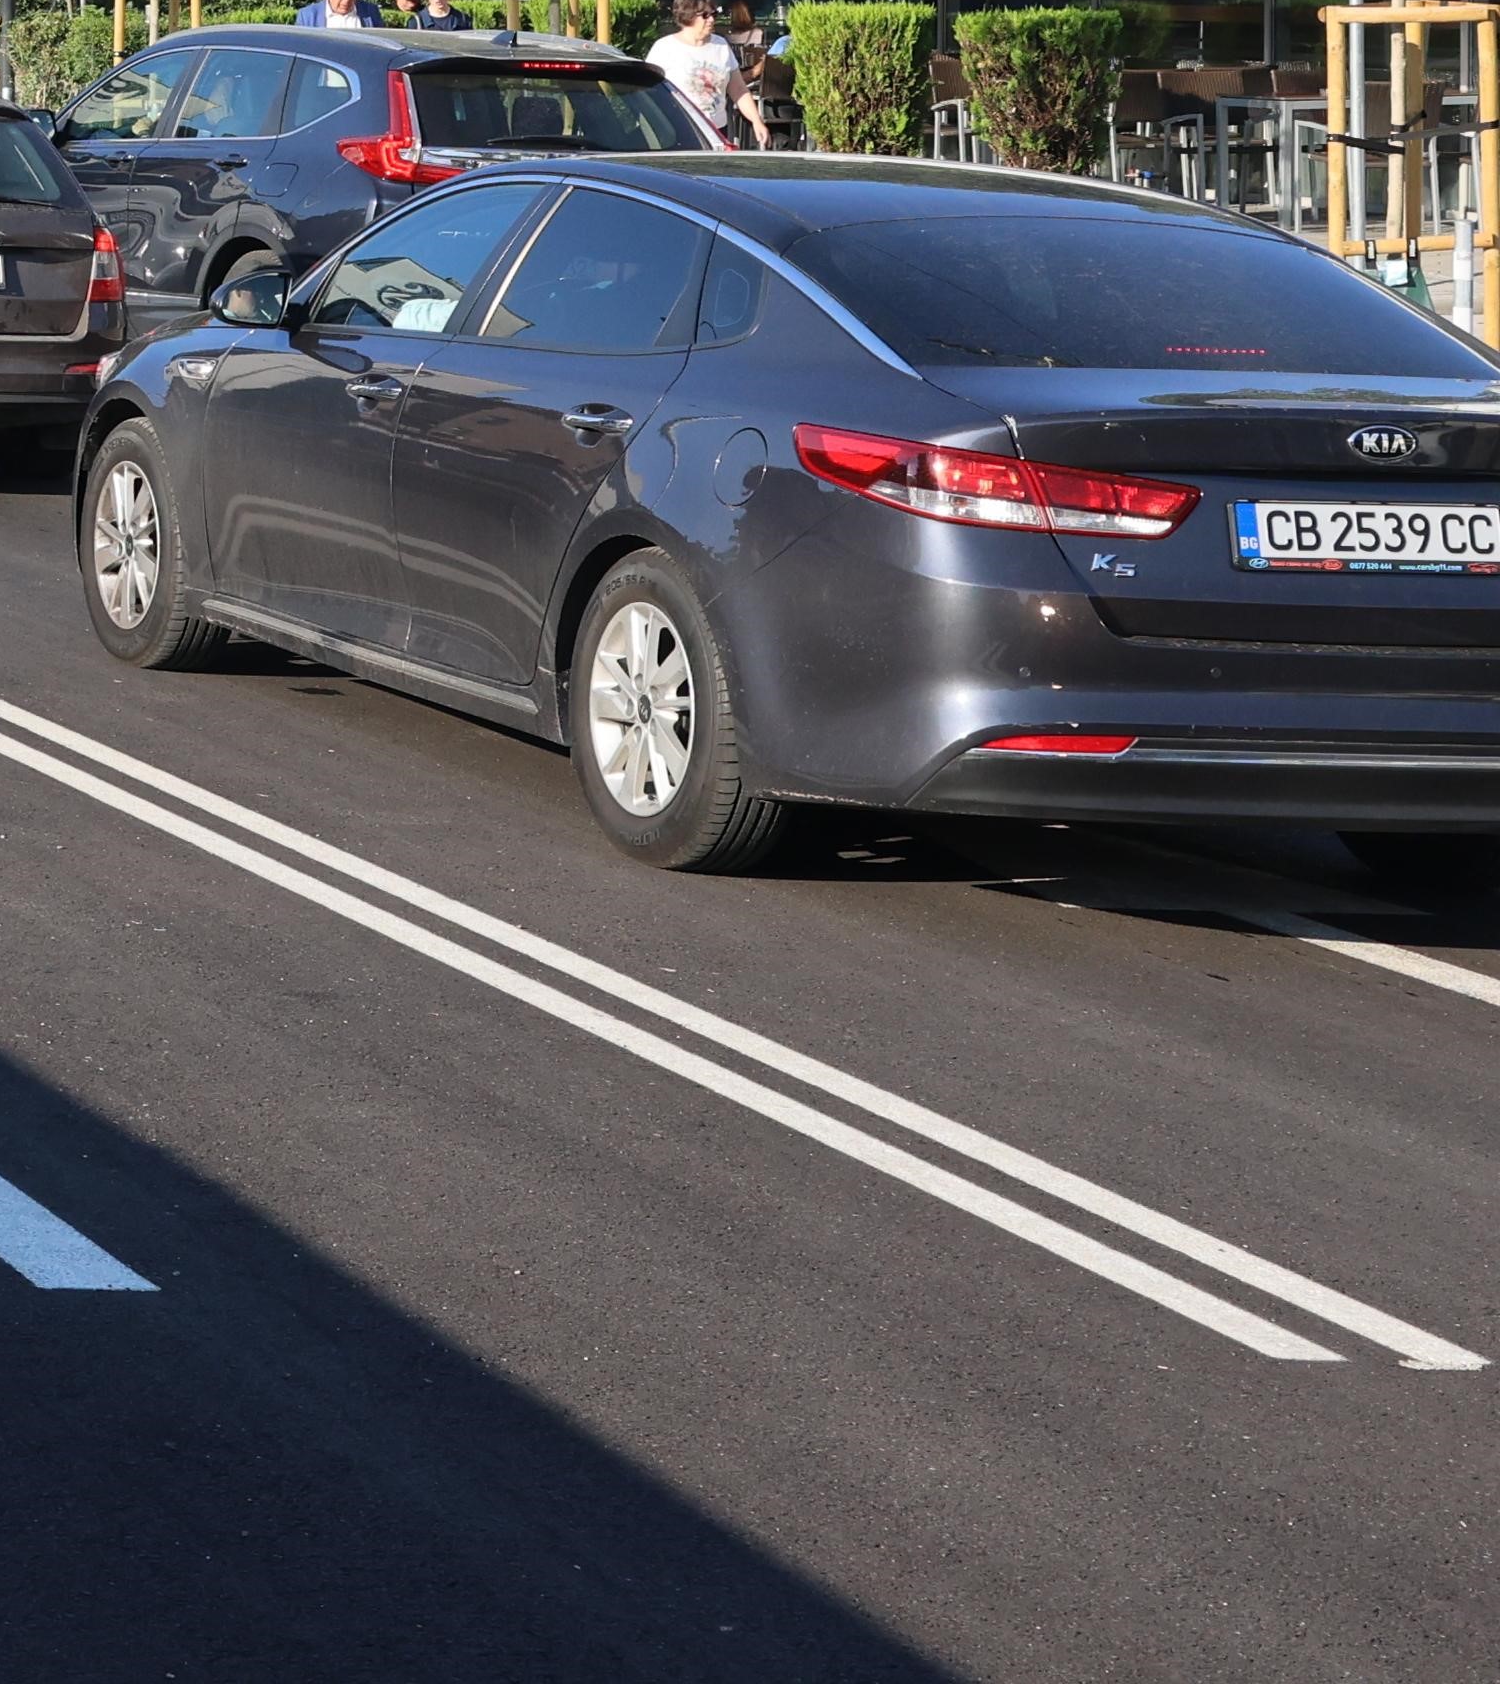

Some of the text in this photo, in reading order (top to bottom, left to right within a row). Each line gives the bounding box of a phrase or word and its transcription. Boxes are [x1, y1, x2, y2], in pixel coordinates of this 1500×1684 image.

[1362, 432, 1407, 453] KIA
[1240, 537, 1259, 549] BG
[1266, 510, 1495, 555] CB 2539 CC
